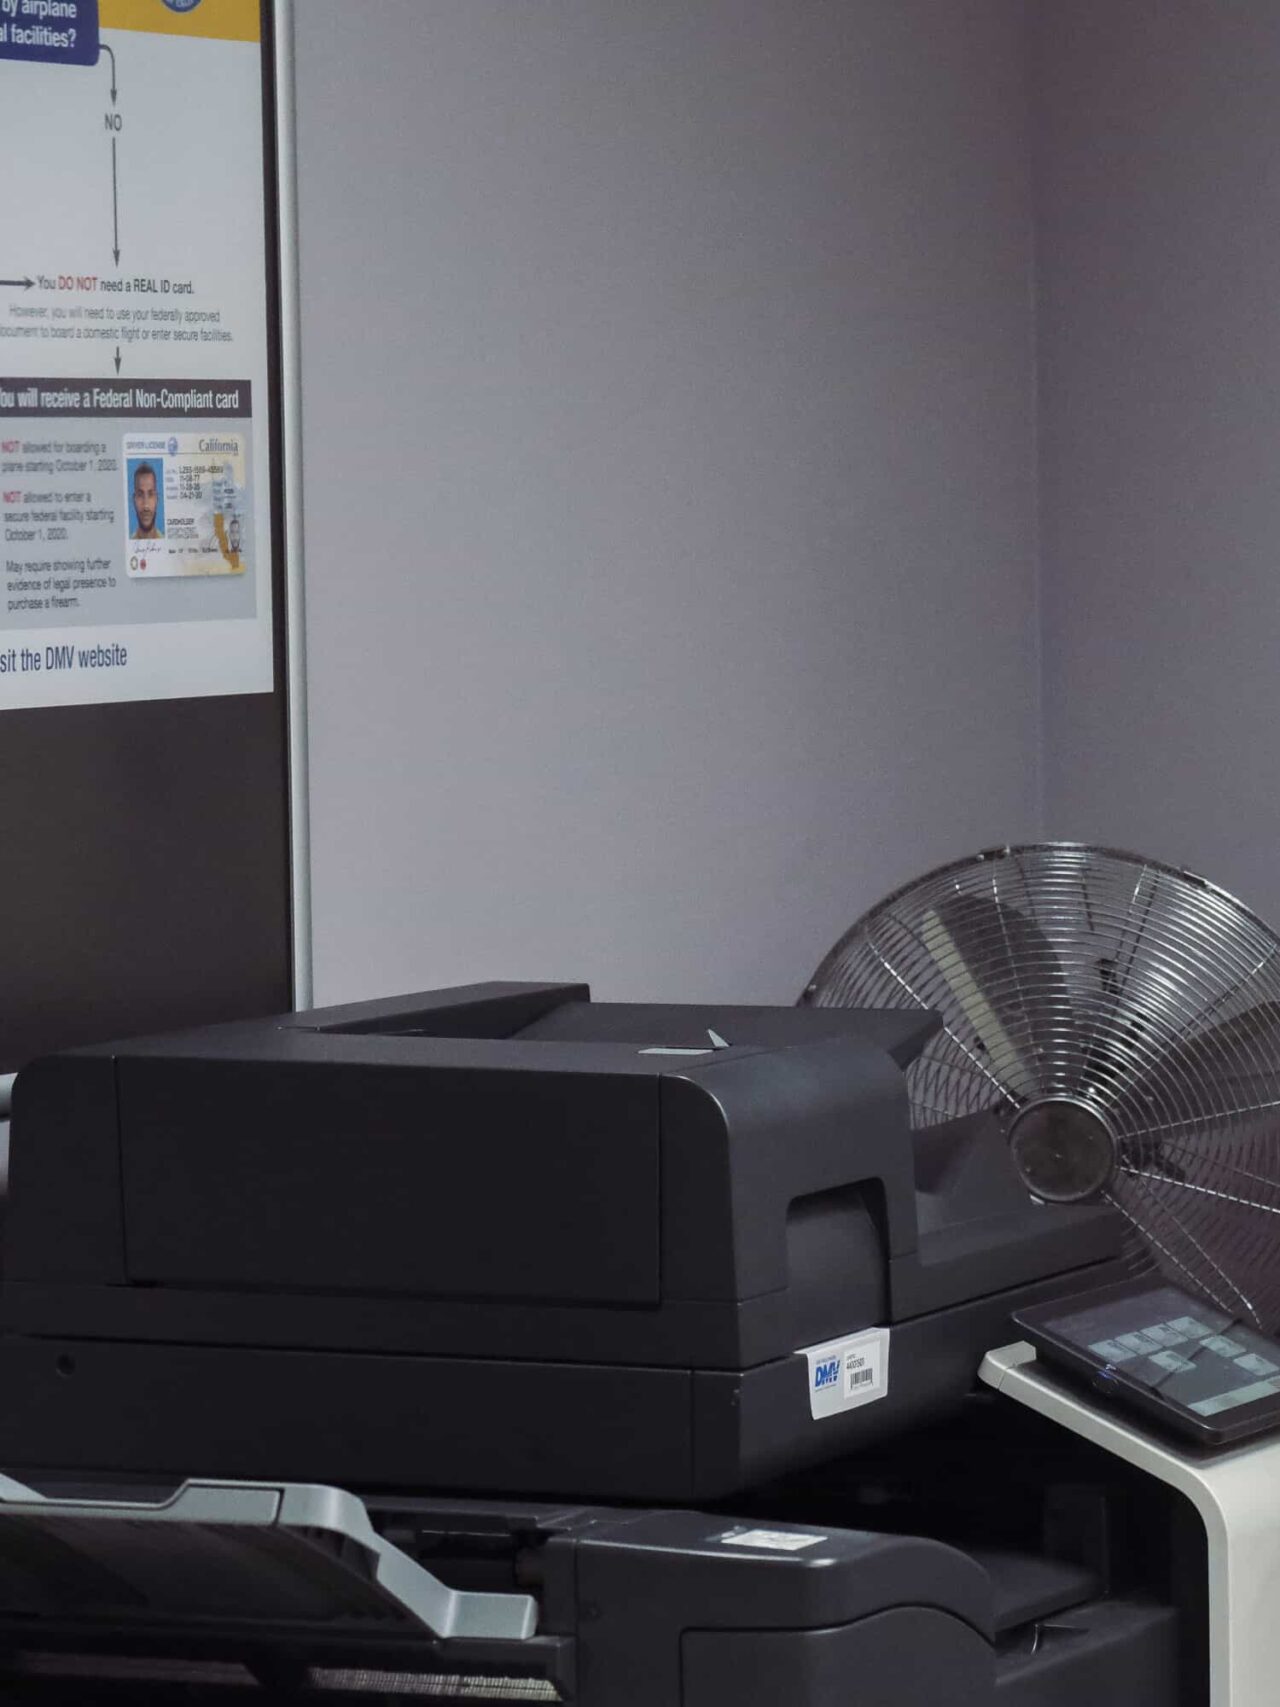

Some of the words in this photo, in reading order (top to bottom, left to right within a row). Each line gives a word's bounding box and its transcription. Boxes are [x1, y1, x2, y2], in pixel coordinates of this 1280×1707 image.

[21, 0, 77, 20] airplane
[11, 24, 76, 48] facilities?
[104, 113, 122, 131] NO
[37, 275, 56, 290] You
[58, 275, 74, 290] DO
[77, 276, 98, 292] NOT
[100, 279, 123, 292] need
[125, 281, 131, 293] a
[133, 278, 158, 293] REAL
[160, 279, 171, 293] ID
[172, 280, 195, 295] card.
[0, 387, 14, 408] ou
[17, 387, 38, 408] will
[40, 387, 80, 408] receive
[83, 391, 90, 408] a
[93, 387, 133, 408] Federal
[135, 388, 213, 413] Non-Compliant
[215, 389, 239, 409] card
[198, 437, 239, 453] California
[6, 560, 22, 574] May
[20, 648, 41, 672] the
[46, 645, 75, 670] DMV
[78, 643, 128, 668] website
